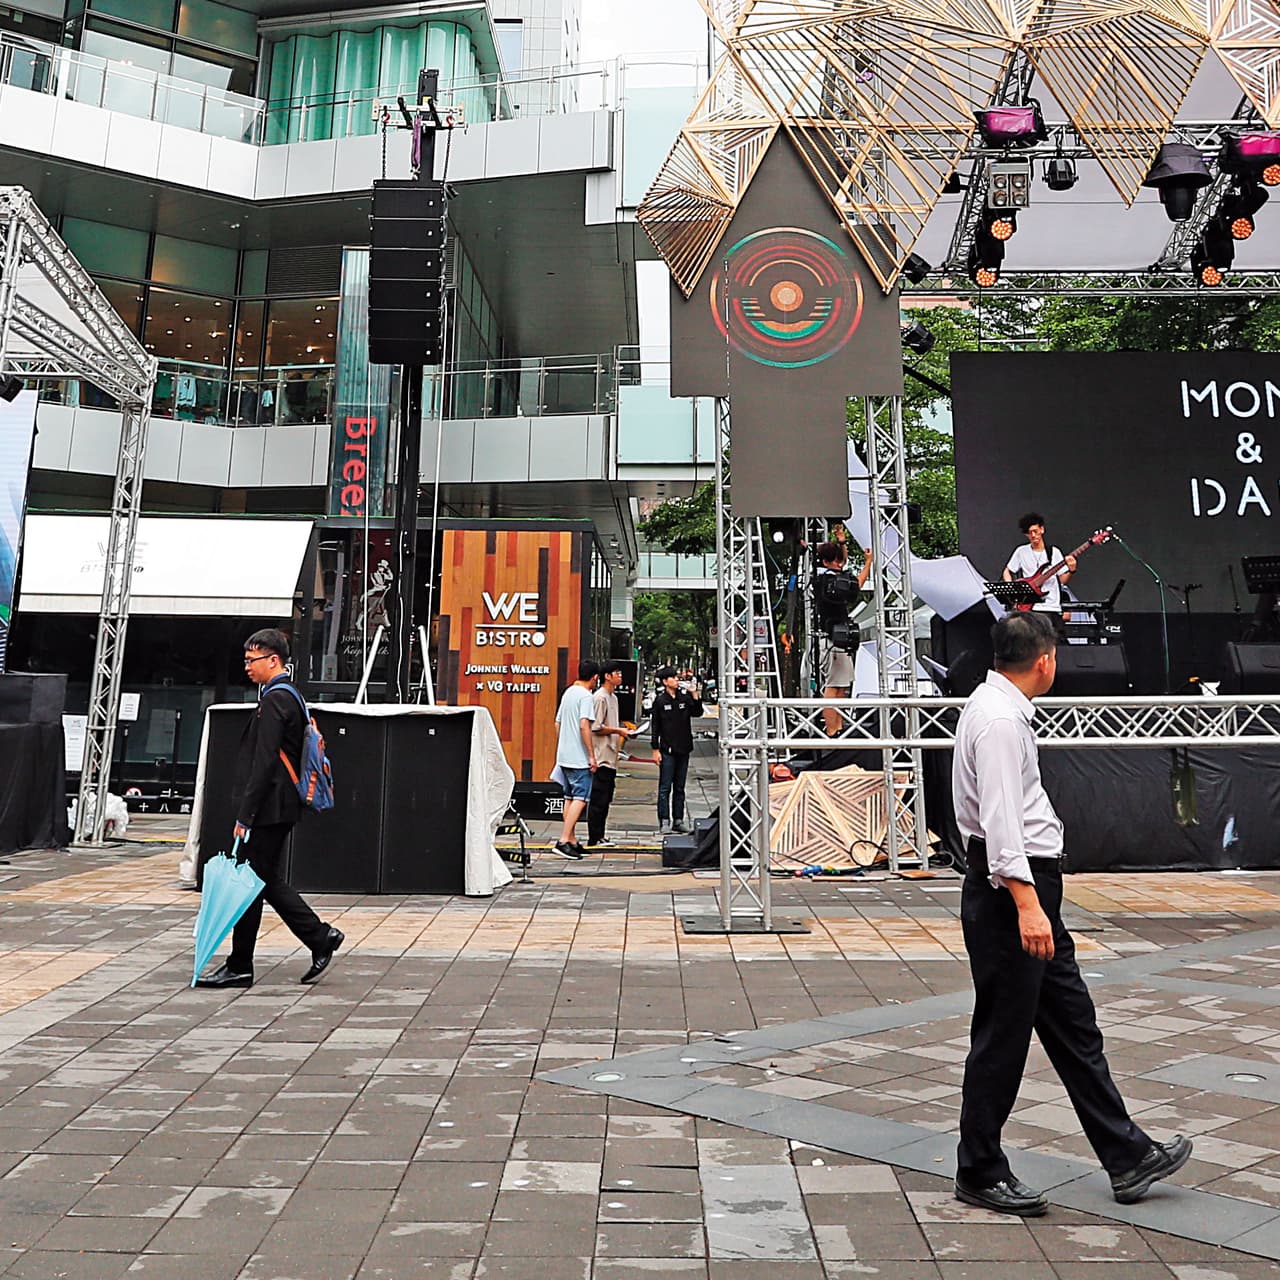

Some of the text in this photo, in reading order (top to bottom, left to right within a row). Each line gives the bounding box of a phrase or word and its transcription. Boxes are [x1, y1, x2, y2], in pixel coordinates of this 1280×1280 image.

[1235, 431, 1263, 464] &
[481, 592, 540, 622] WE
[476, 631, 546, 646] BISTRO
[505, 682, 541, 692] TAIPEI
